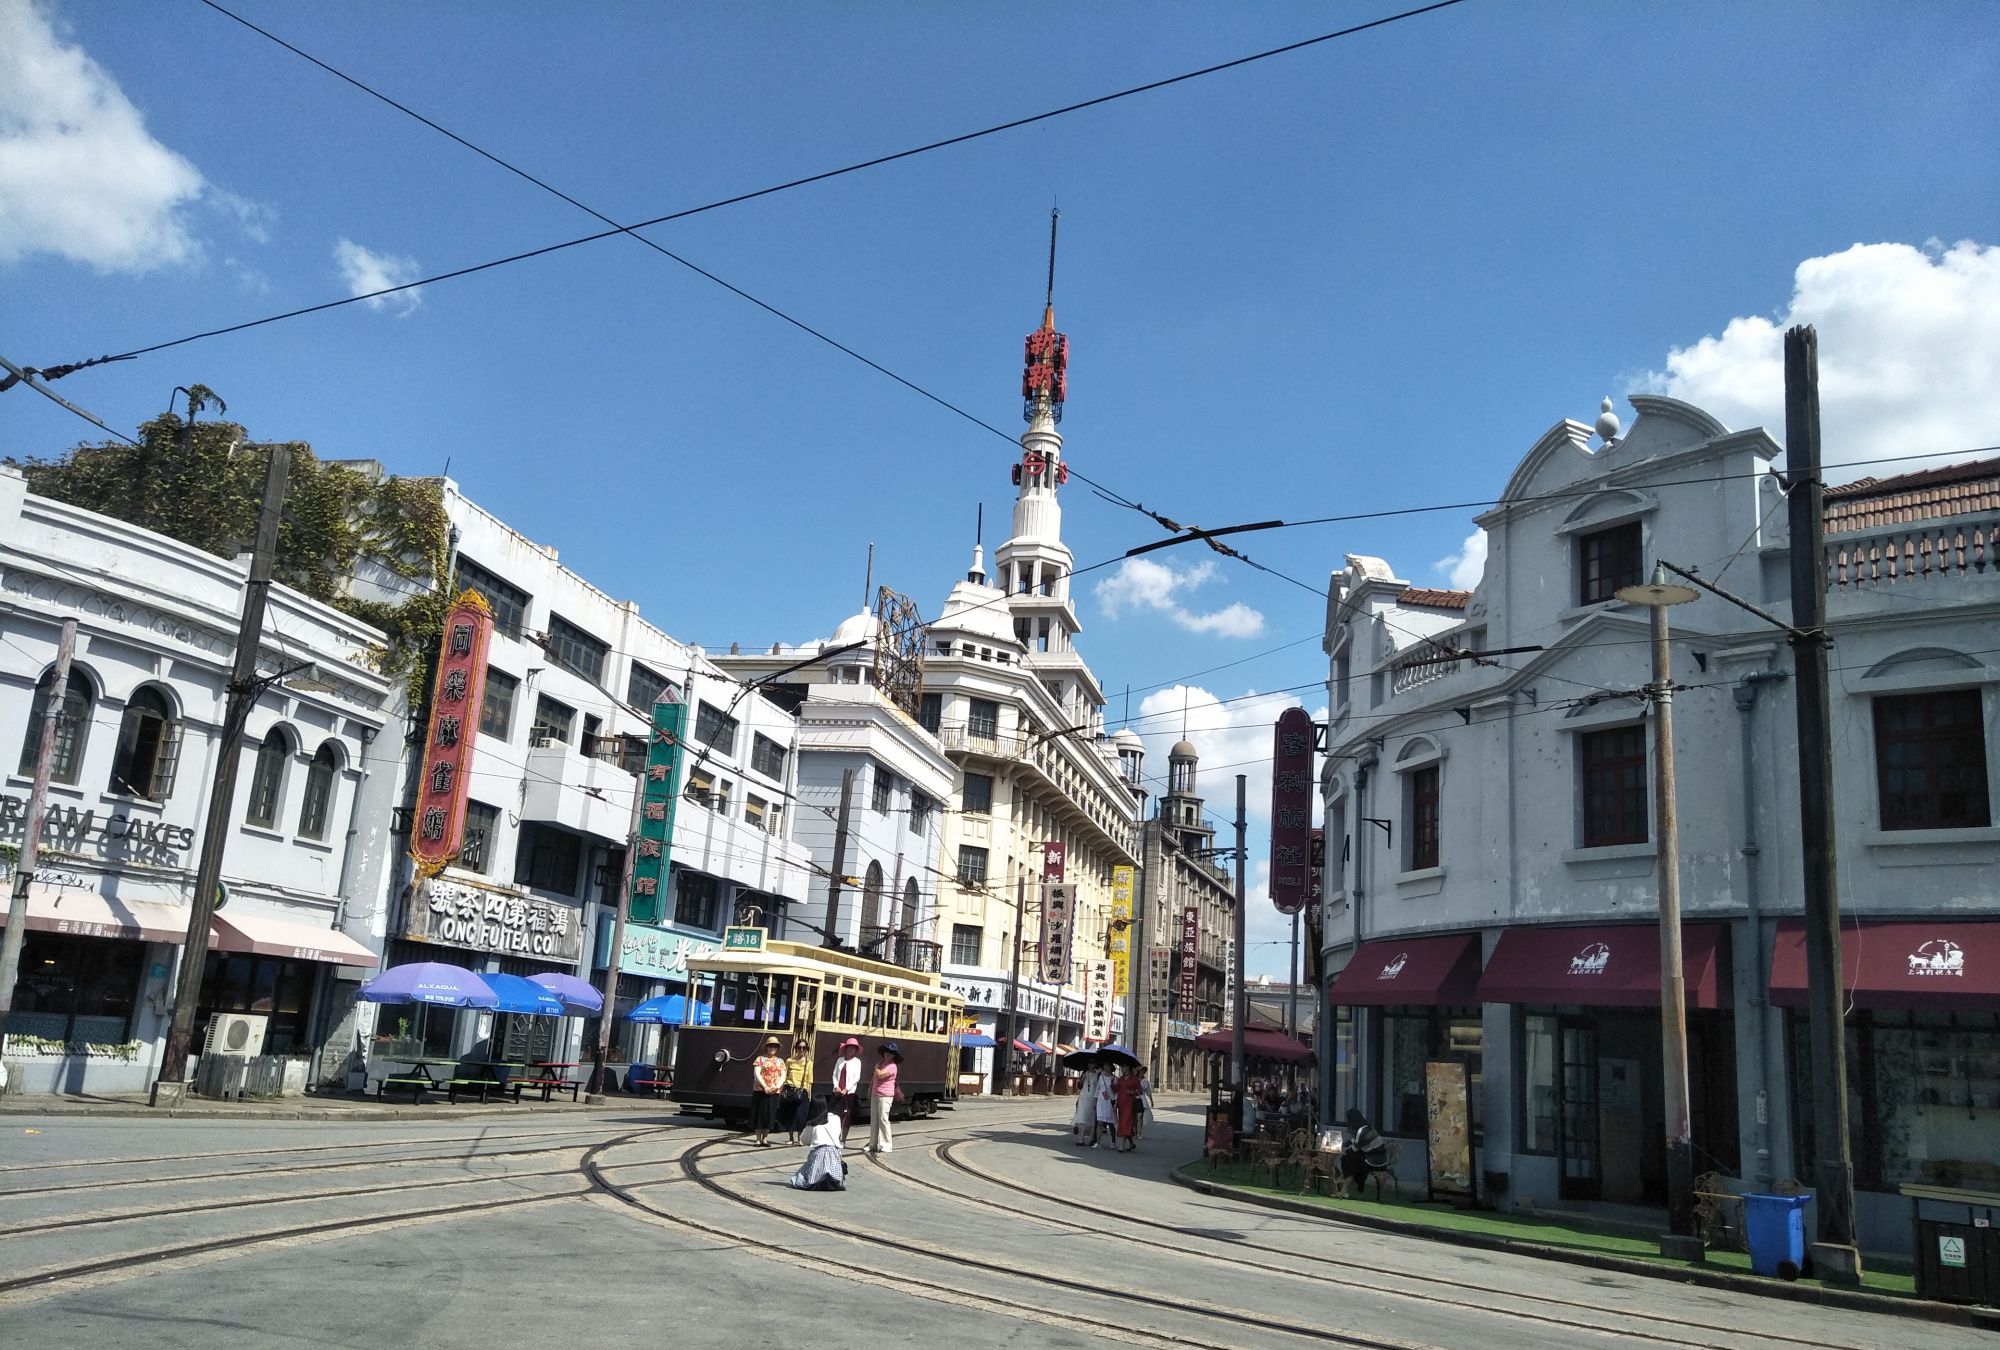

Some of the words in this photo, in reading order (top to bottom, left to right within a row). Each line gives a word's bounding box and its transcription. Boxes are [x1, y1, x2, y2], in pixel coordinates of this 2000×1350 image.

[0, 794, 94, 836] RAM
[105, 813, 195, 850] CAKES
[480, 925, 500, 947] FU
[504, 929, 529, 952] TEA
[533, 934, 552, 955] CO
[1183, 911, 1195, 968] 東亞旅館
